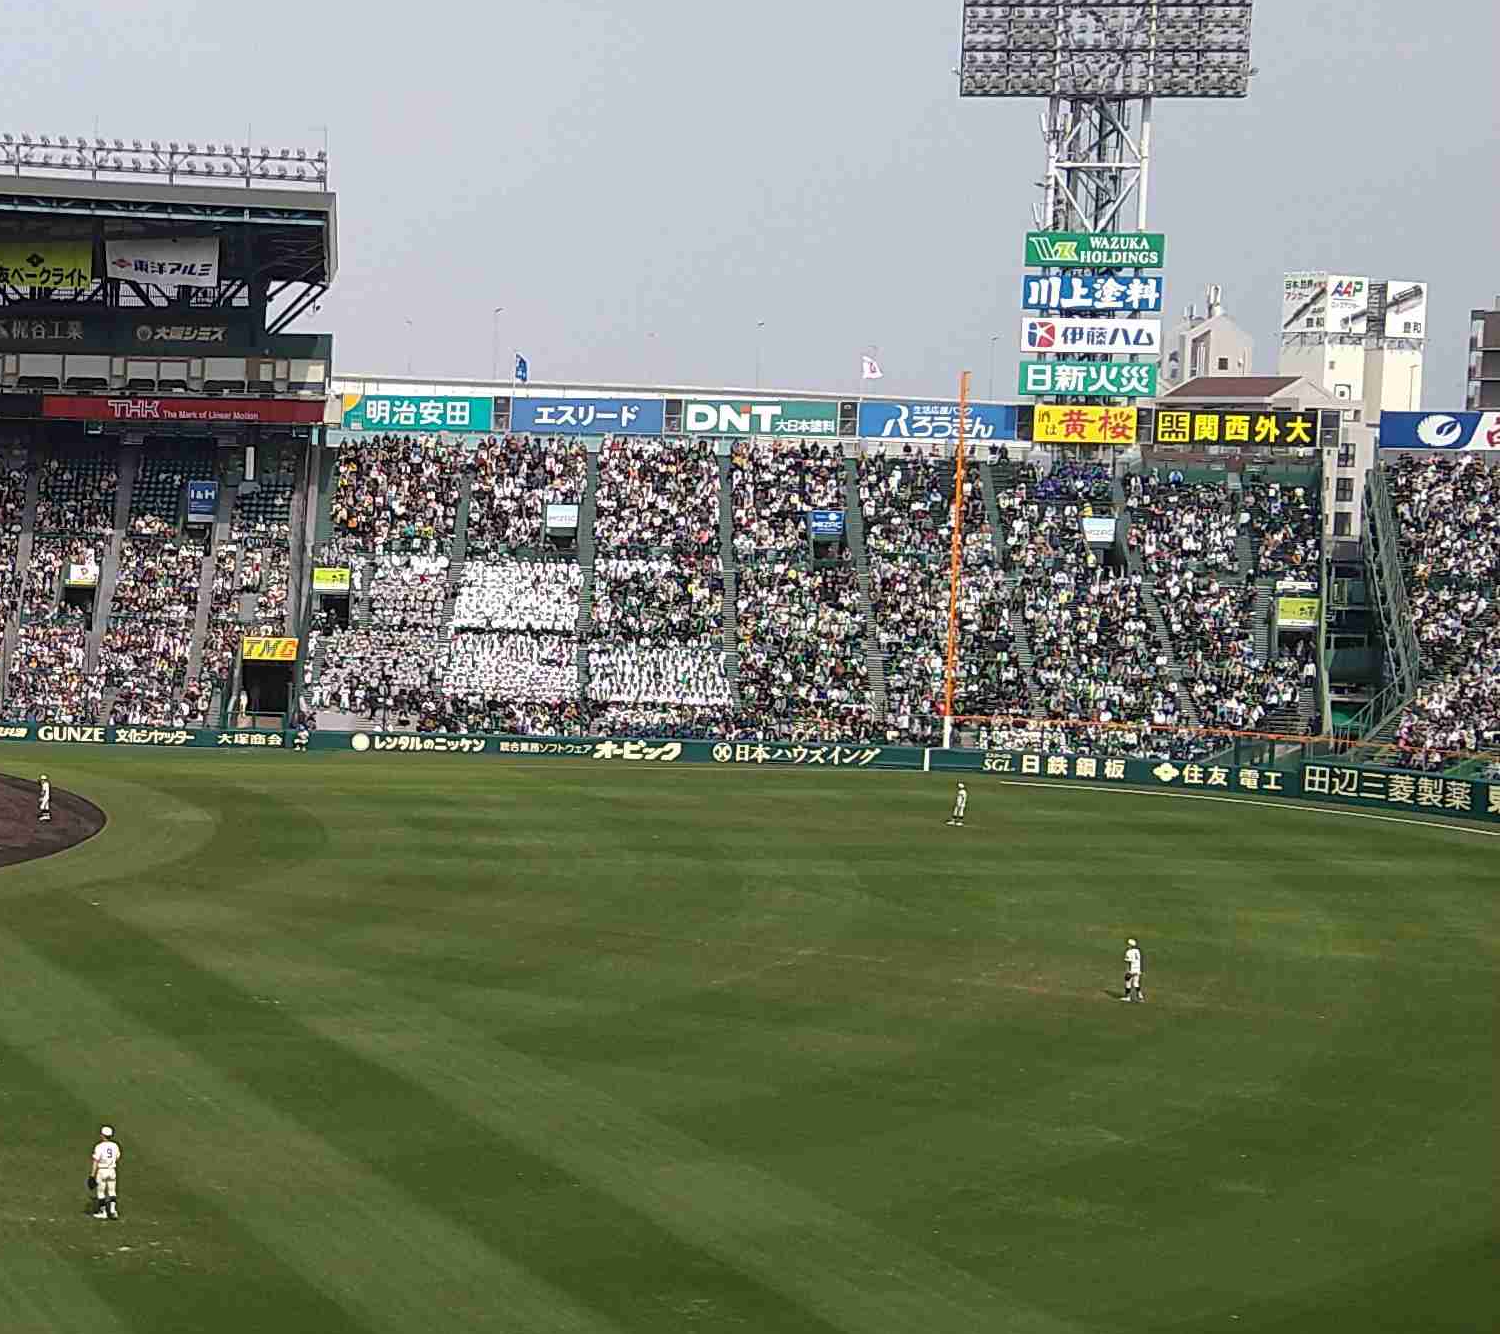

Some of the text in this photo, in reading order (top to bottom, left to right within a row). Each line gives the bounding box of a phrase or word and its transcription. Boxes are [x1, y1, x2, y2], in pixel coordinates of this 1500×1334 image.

[1090, 237, 1150, 250] WAZUKA
[1080, 251, 1158, 264] HOLDINGS
[132, 260, 213, 278] 東洋アルミ
[1028, 277, 1160, 308] 川上塗料
[1331, 280, 1364, 297] AAP
[1060, 326, 1155, 347] 伊藤ハム
[1026, 364, 1150, 394] 日新火災
[108, 401, 160, 419] THK
[163, 411, 178, 419] The
[180, 411, 198, 419] Mark
[366, 400, 471, 426] 明治安田
[535, 405, 640, 428] エスリード
[686, 402, 782, 432] DNT
[775, 419, 835, 434] 大日本塗料
[910, 417, 994, 438] ろうきん
[1060, 408, 1137, 441] 黄桜
[1194, 415, 1312, 443] 関西外大
[38, 726, 105, 743] GUNZE
[218, 733, 283, 746] 大塚商会
[374, 736, 486, 751] レンタルのニッケン
[592, 740, 682, 761] オービック
[734, 744, 881, 765] 日本ハウズイング
[1021, 754, 1126, 779] 日鉄鋼板
[1304, 765, 1472, 812] 田辺三菱製薬
